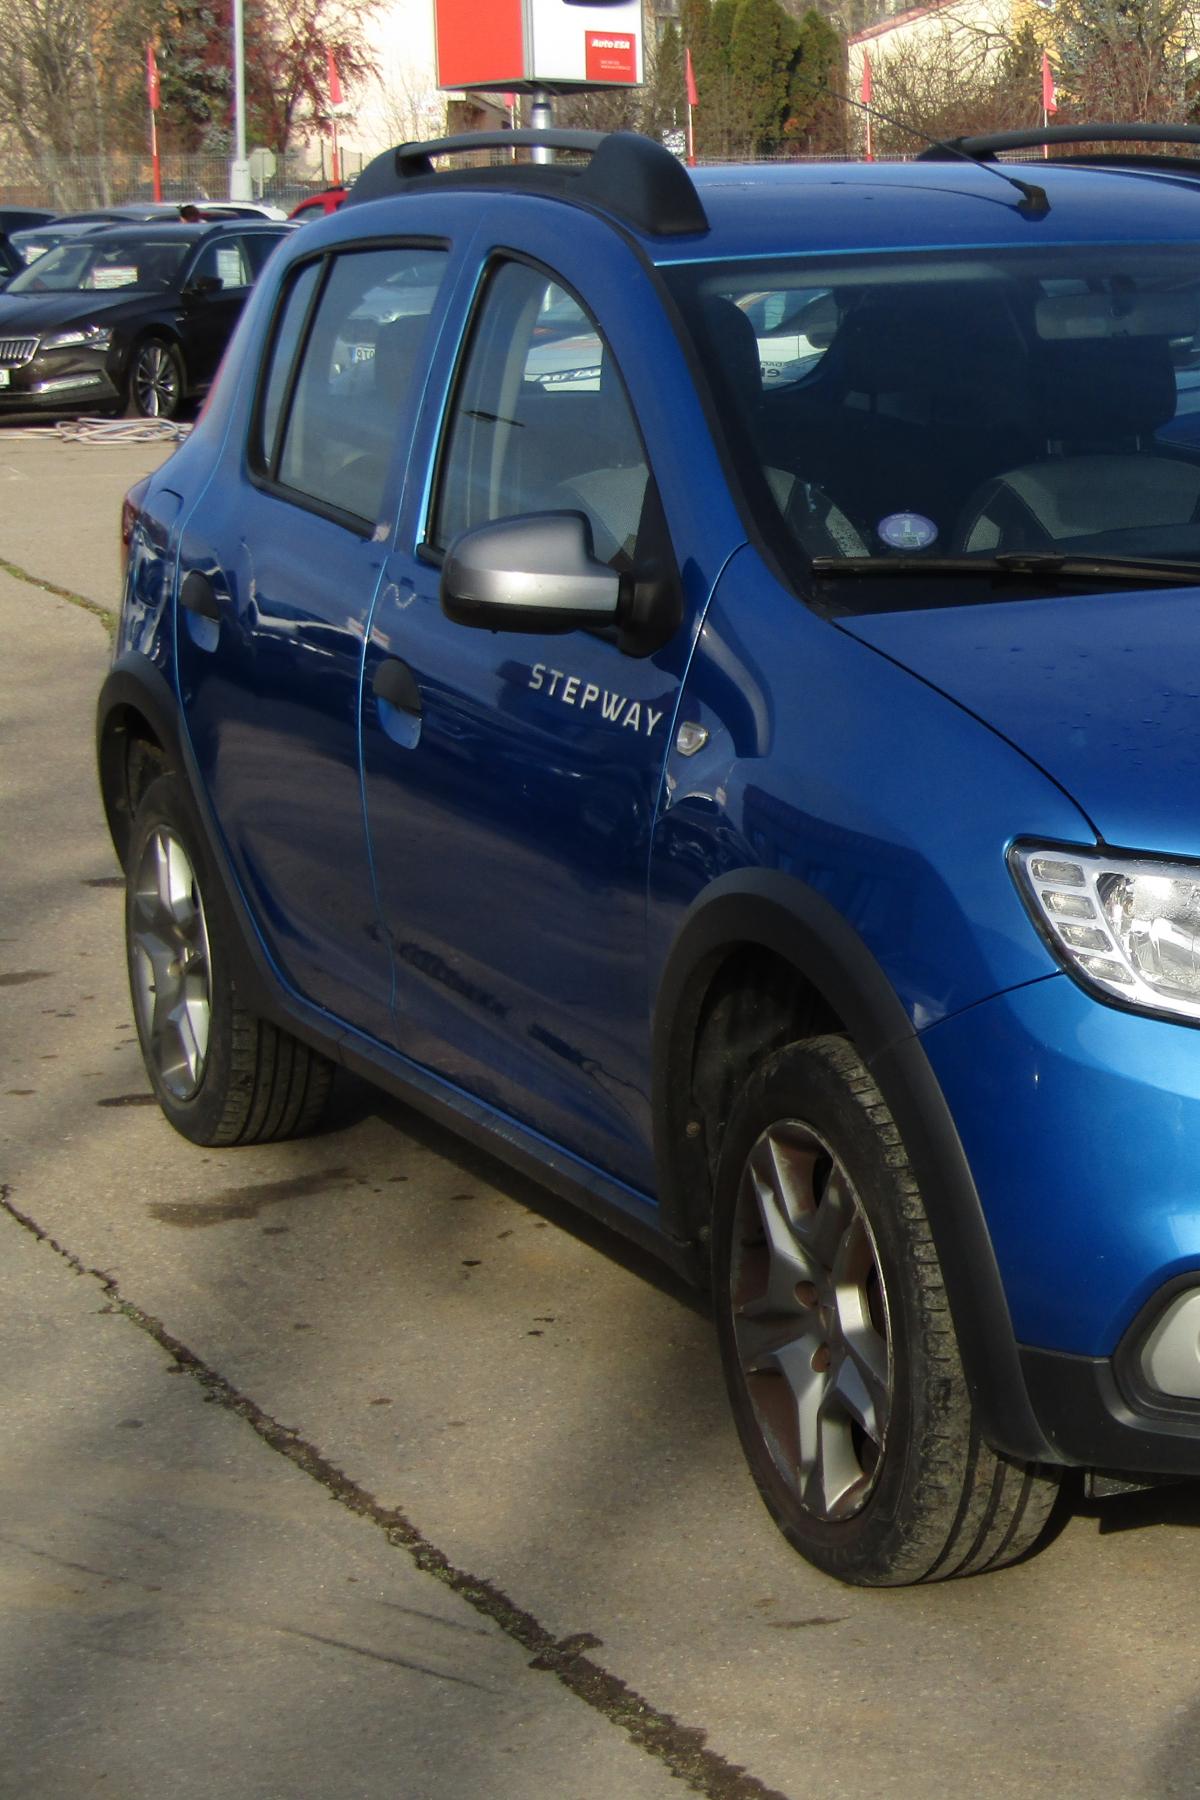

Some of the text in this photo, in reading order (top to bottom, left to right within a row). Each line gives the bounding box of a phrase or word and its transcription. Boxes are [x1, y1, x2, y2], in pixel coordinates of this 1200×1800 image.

[591, 39, 630, 49] Auto ESA
[528, 663, 664, 736] STEPWAY
